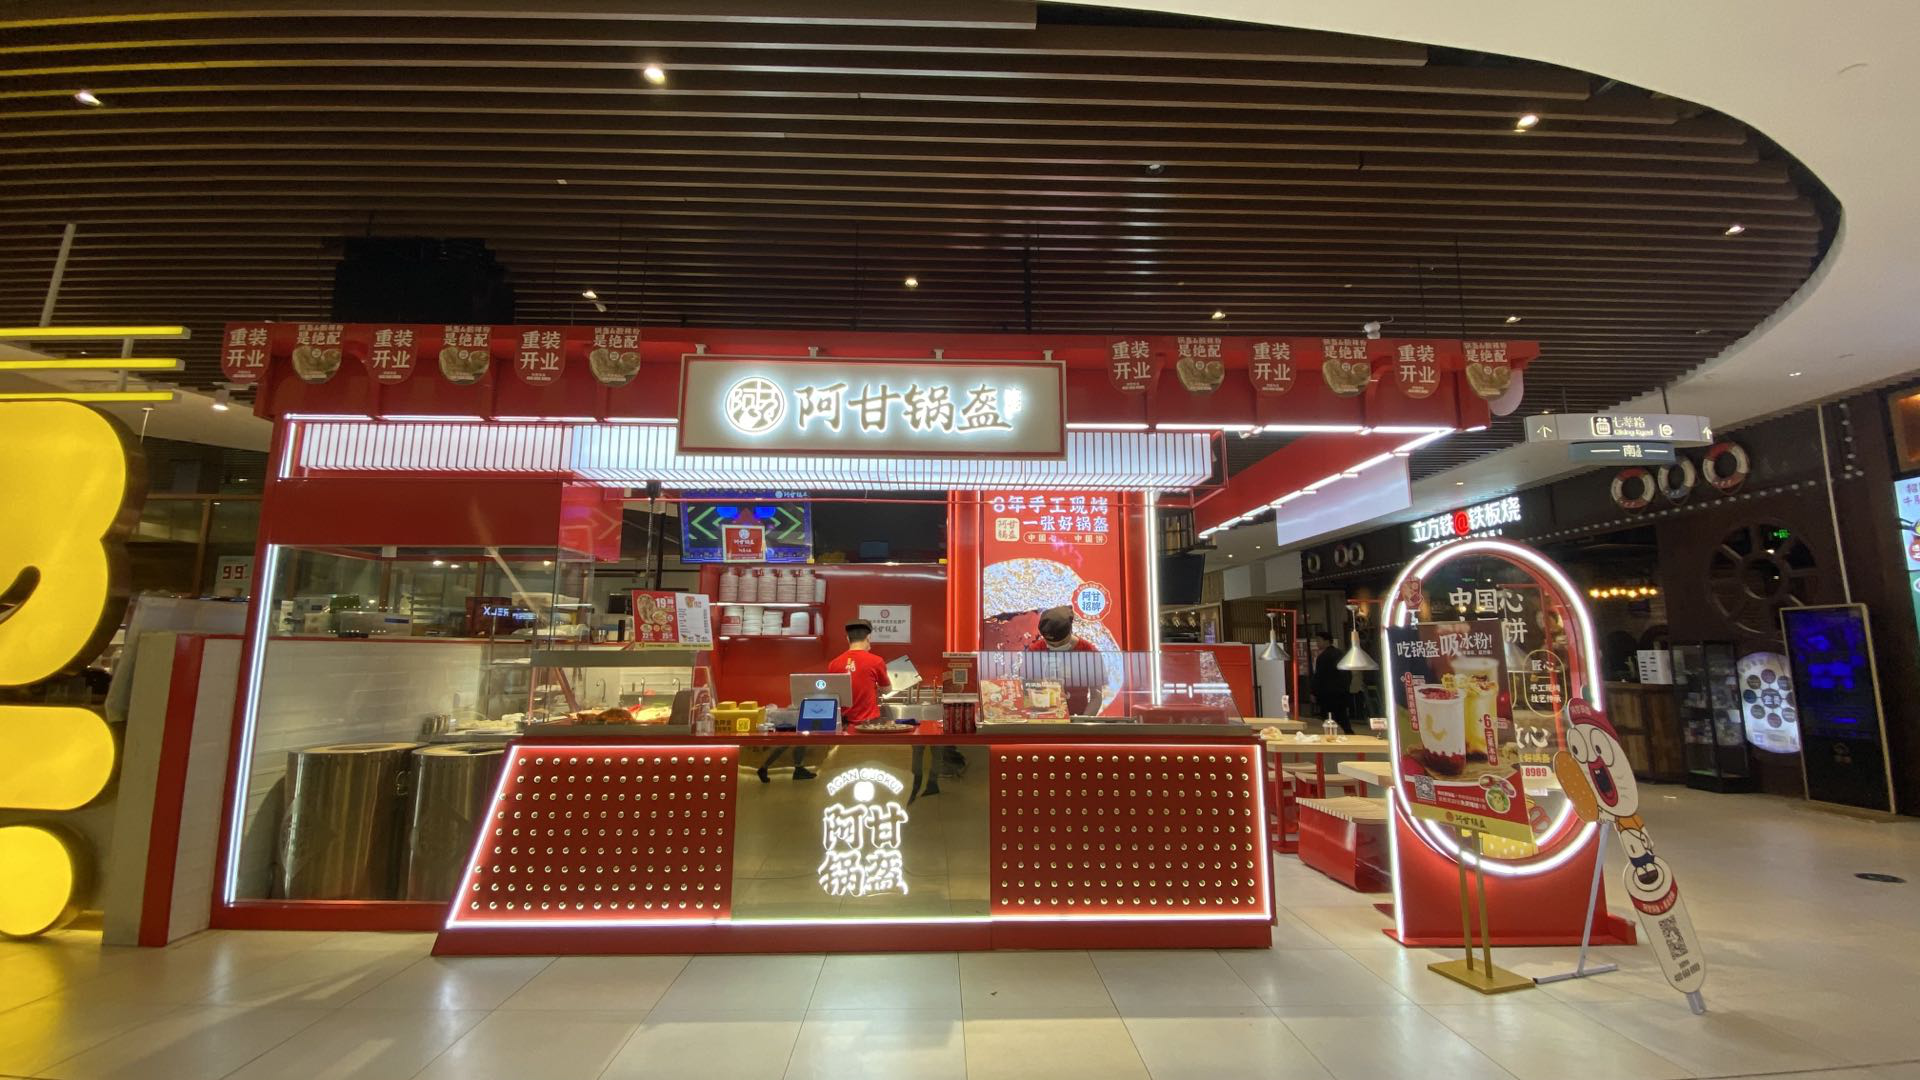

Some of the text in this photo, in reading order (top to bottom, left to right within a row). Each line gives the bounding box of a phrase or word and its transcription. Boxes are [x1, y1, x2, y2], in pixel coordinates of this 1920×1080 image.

[228, 328, 268, 346] 重装
[297, 332, 341, 345] 是绝配
[375, 330, 413, 348] 重装
[443, 332, 488, 347] 是绝配
[521, 331, 561, 349] 重装
[593, 334, 639, 348] 是绝配
[227, 349, 265, 367] 开业
[1112, 341, 1151, 359] 重装
[1178, 344, 1221, 357] 是绝配
[1253, 342, 1291, 360] 重装
[1324, 345, 1367, 359] 是绝配
[1398, 344, 1435, 362] 重装
[1466, 350, 1508, 363] 是绝配
[372, 351, 411, 369] 开业
[520, 352, 559, 370] 开业
[1113, 362, 1151, 380] 开业
[1254, 363, 1291, 381] 开业
[1399, 365, 1436, 383] 开业
[794, 381, 1014, 432] 阿甘锅盔
[1023, 515, 1109, 533] 一张好锅盔
[1081, 591, 1101, 601] 阿甘
[1449, 587, 1523, 614] 中国心
[1081, 602, 1101, 612] 招牌
[1396, 632, 1493, 658] 吃锅盔吸冰粉!
[1531, 659, 1555, 672] 匠心
[827, 768, 858, 796] AGAN
[823, 802, 909, 850] 阿甘
[817, 848, 909, 897] 锅盔
